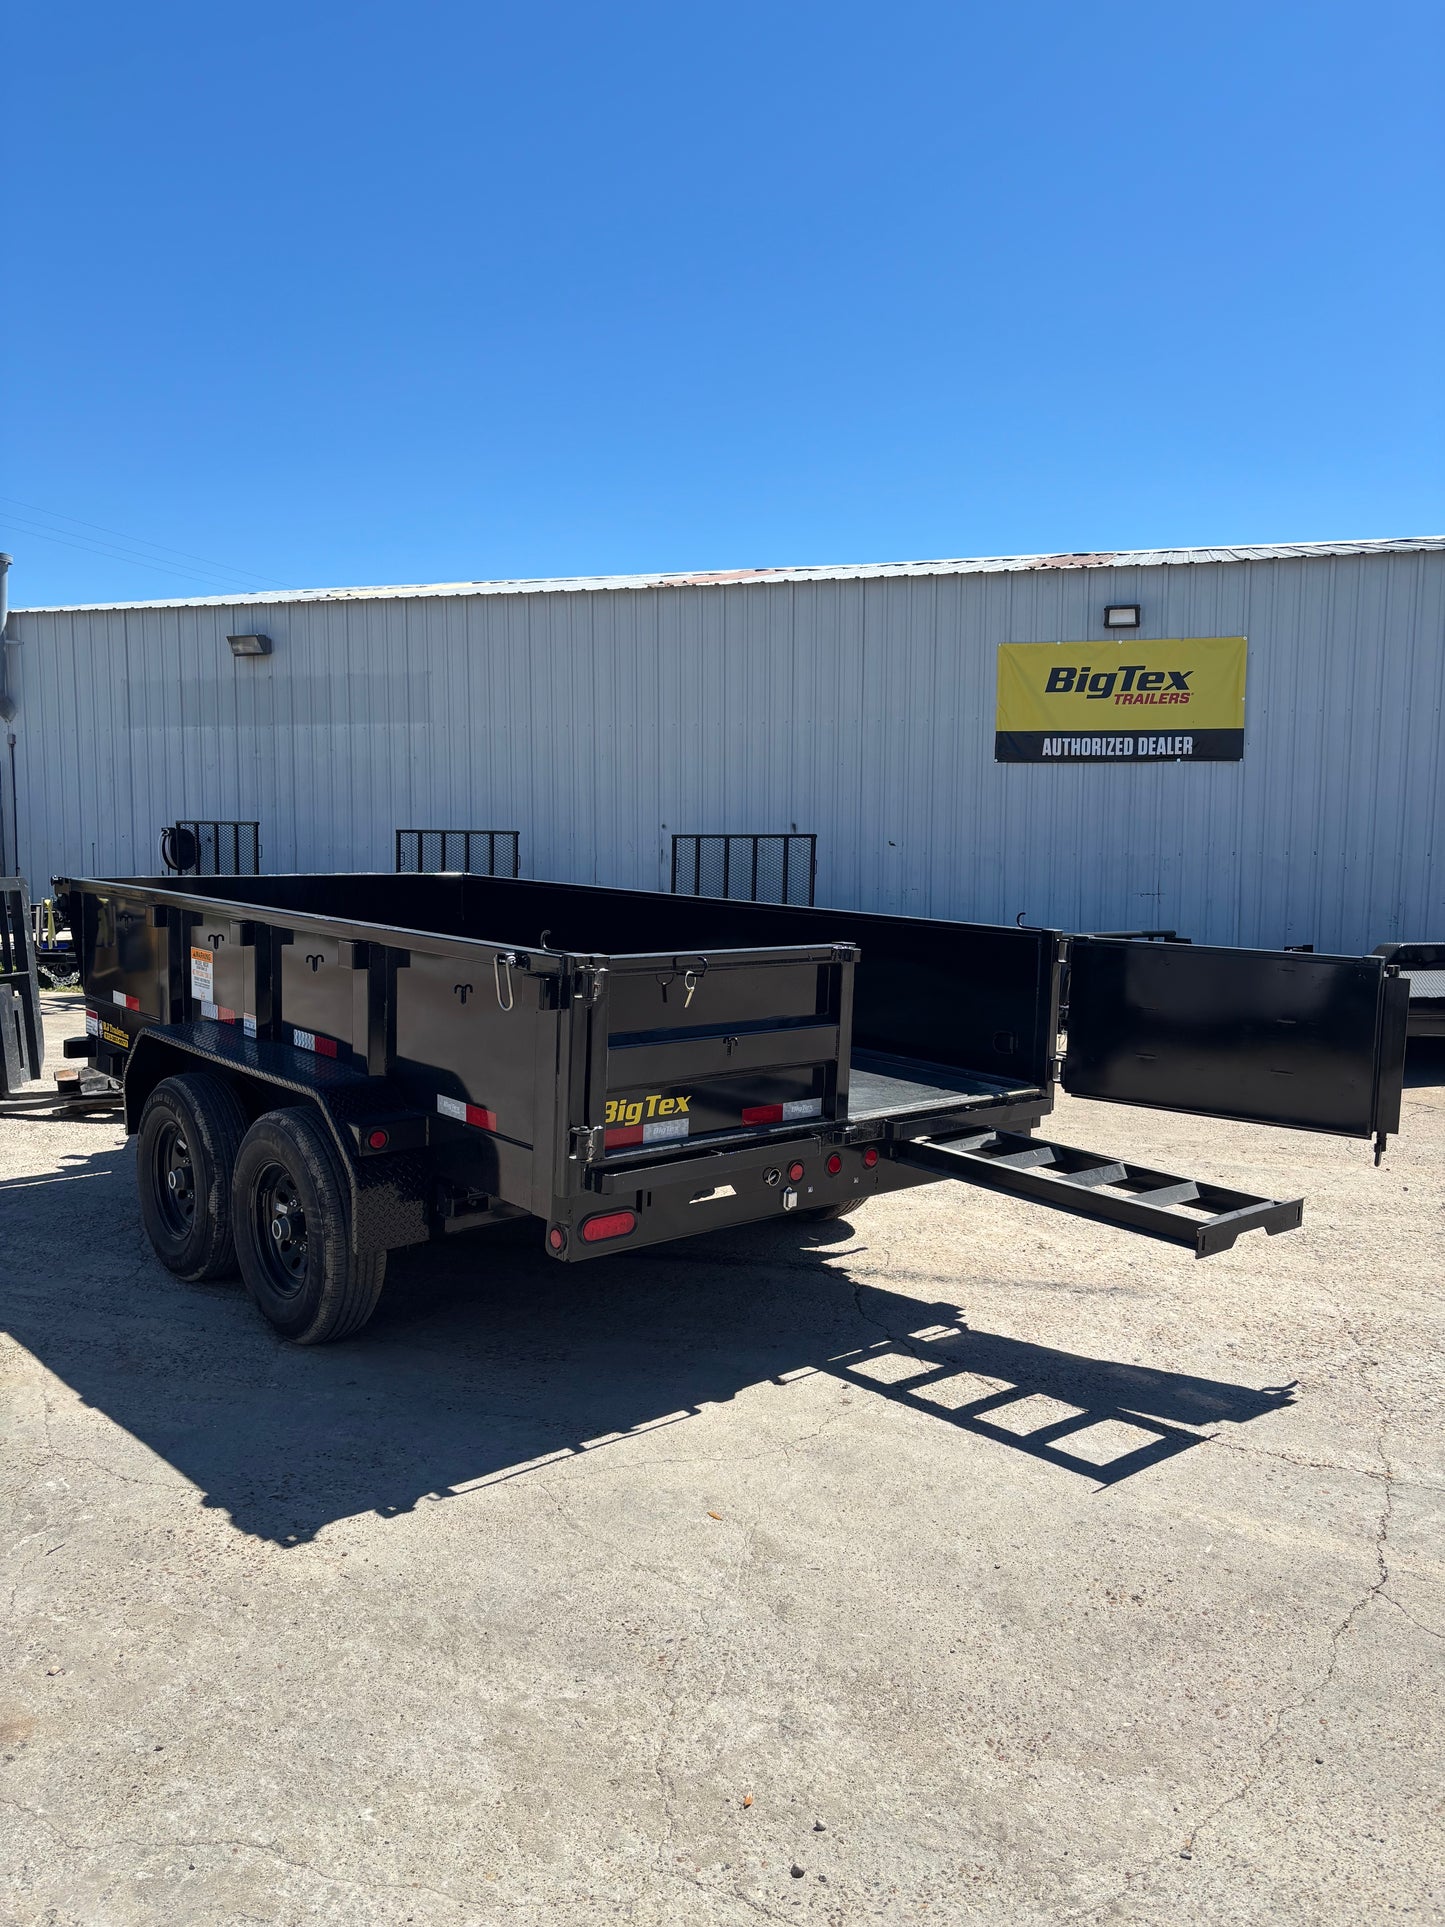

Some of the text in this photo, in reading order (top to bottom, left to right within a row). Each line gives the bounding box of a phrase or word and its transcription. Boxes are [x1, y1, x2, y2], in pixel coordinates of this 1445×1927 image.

[1045, 665, 1194, 699] BigTex
[1114, 692, 1191, 705] TRAILERS
[1042, 736, 1193, 756] AUTHORIZED DEALER
[653, 1125, 679, 1135] BigTex
